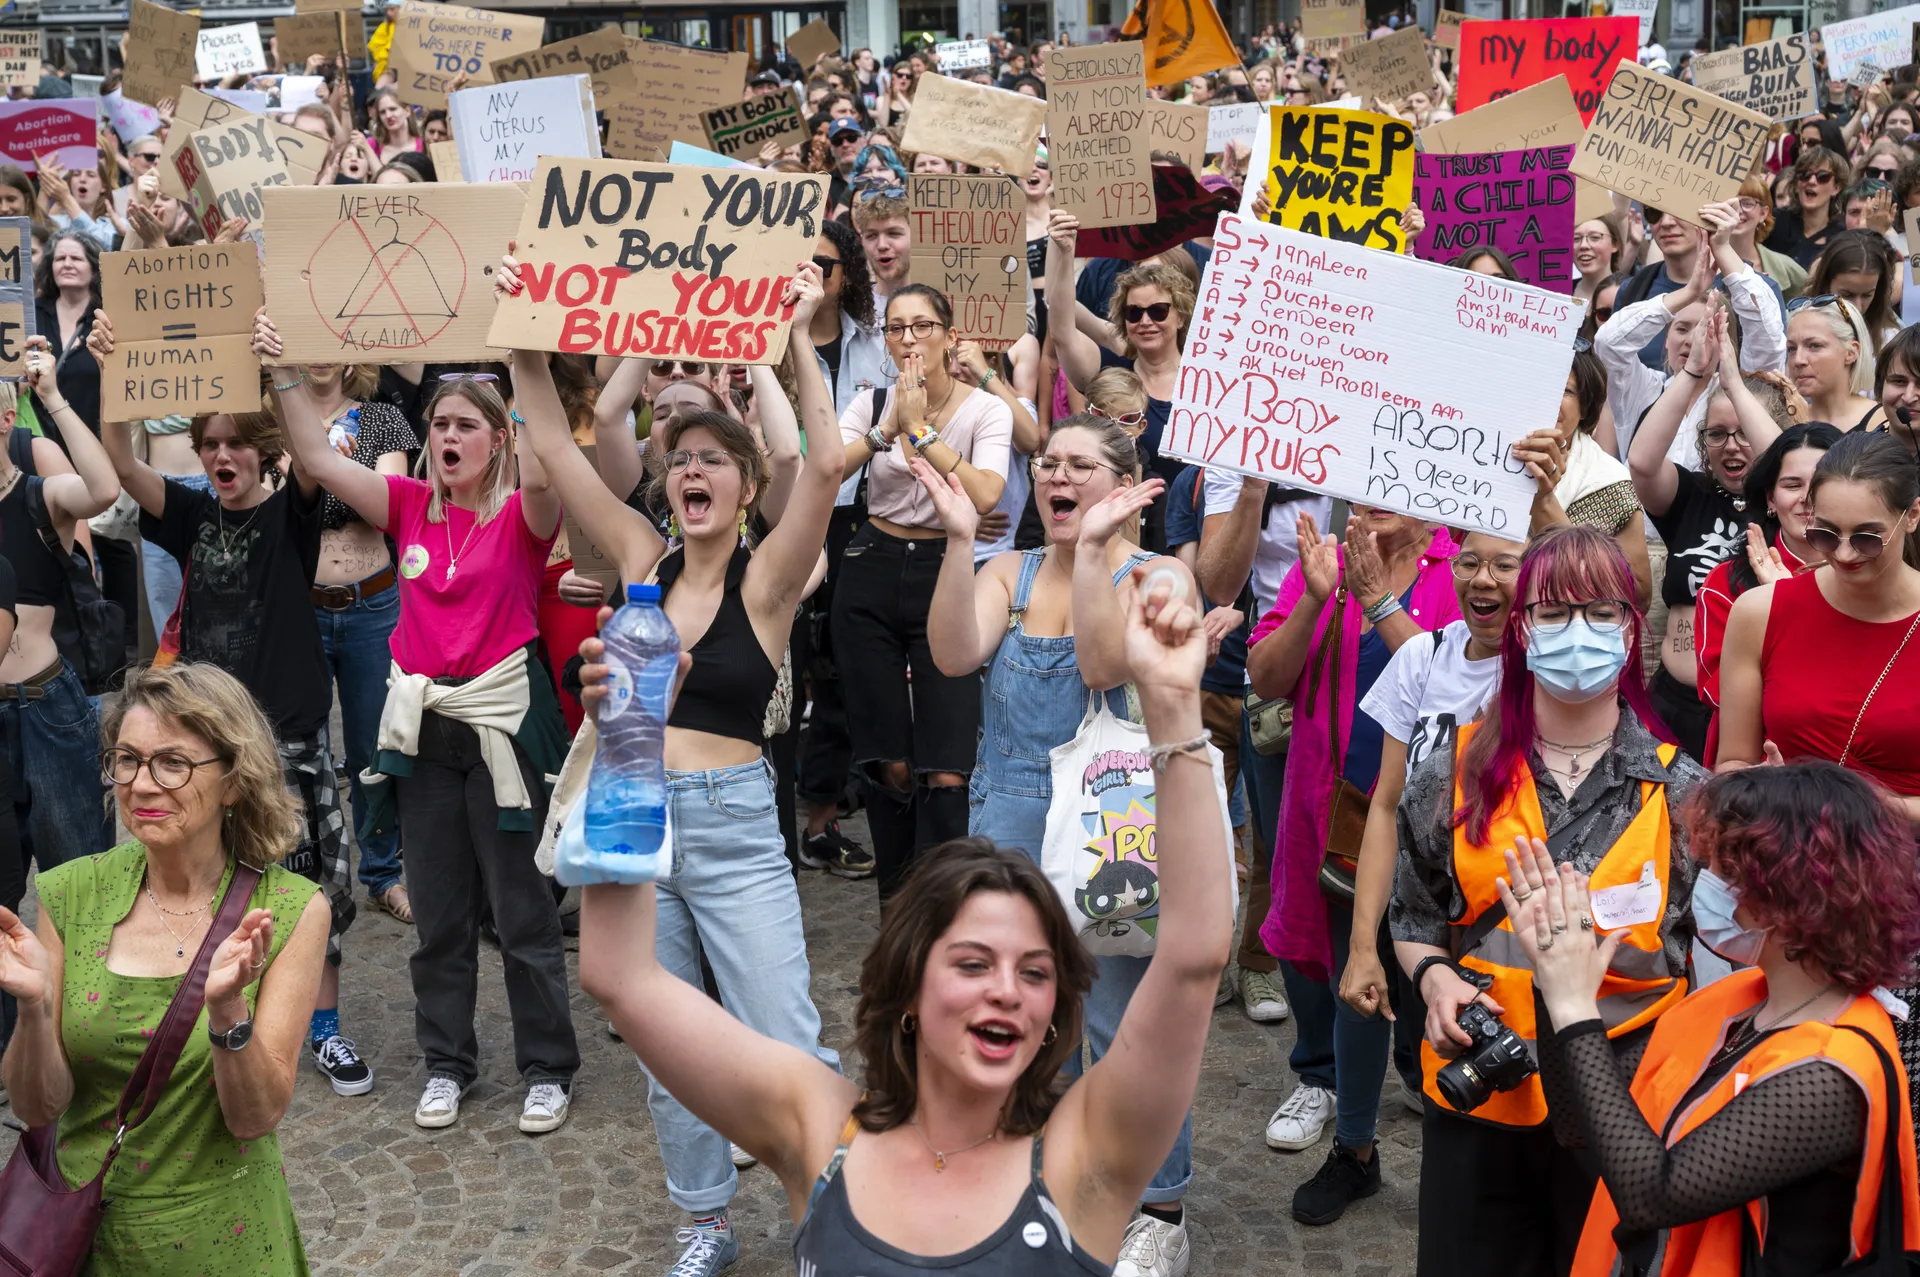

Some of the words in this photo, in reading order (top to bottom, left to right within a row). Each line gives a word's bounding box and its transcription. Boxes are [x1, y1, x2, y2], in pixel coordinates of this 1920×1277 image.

[1481, 34, 1526, 79] my
[1544, 28, 1621, 79] body
[1743, 35, 1807, 76] BAAS
[1834, 27, 1902, 55] PERSONAL
[433, 53, 482, 75] TOO
[1051, 52, 1142, 82] SERIOUSLY?
[1749, 65, 1802, 99] BUIK
[487, 91, 520, 120] MY
[1053, 90, 1079, 113] MY
[1092, 84, 1141, 109] MOM
[1607, 69, 1699, 129] GIRLS
[1695, 107, 1771, 156] JUST
[15, 114, 72, 132] Abortion
[708, 105, 738, 131] MY
[1066, 110, 1145, 136] ALREADY
[1210, 107, 1244, 121] STOP
[9, 132, 81, 151] healthcare
[194, 118, 274, 169] BODY
[480, 116, 545, 143] UTERUS
[1520, 122, 1560, 149] your
[1595, 100, 1675, 154] WANNA
[1677, 132, 1753, 184] HAVE
[495, 142, 524, 161] MY
[717, 135, 741, 156] MY
[1057, 136, 1131, 161] MARCHED
[1279, 111, 1415, 178] KEEP
[1059, 163, 1089, 183] FOR
[1093, 157, 1136, 179] THIS
[1435, 152, 1504, 179] TRUST
[1519, 146, 1572, 174] ME
[1584, 133, 1723, 204] FUNDAMENTAL
[914, 178, 961, 209] KEEP
[966, 179, 1012, 210] YOUR
[1272, 165, 1386, 210] YOU'RE
[1431, 187, 1447, 213] A
[1454, 173, 1575, 215] CHILD
[1596, 162, 1666, 203] RIGTS
[338, 194, 425, 221] NEVER
[537, 166, 674, 229] NOT
[701, 173, 824, 239] YOUR
[1059, 186, 1086, 205] IN
[1096, 182, 1152, 220] 1973
[911, 210, 1022, 246] THEOLOGY
[1216, 216, 1242, 251] S
[1432, 218, 1507, 251] NOT
[1516, 214, 1545, 245] A
[124, 249, 231, 276] Abortion
[941, 246, 982, 270] OFF
[1214, 249, 1232, 266] P
[511, 262, 633, 307] NOT
[945, 273, 980, 294] MY
[1211, 270, 1225, 286] E
[1205, 287, 1220, 305] A
[1202, 306, 1216, 323] K
[557, 308, 778, 362] BUSINESS
[1197, 325, 1211, 341] U
[1191, 341, 1208, 358] P
[1238, 354, 1262, 373] AK
[1091, 770, 1128, 797] GIRLS
